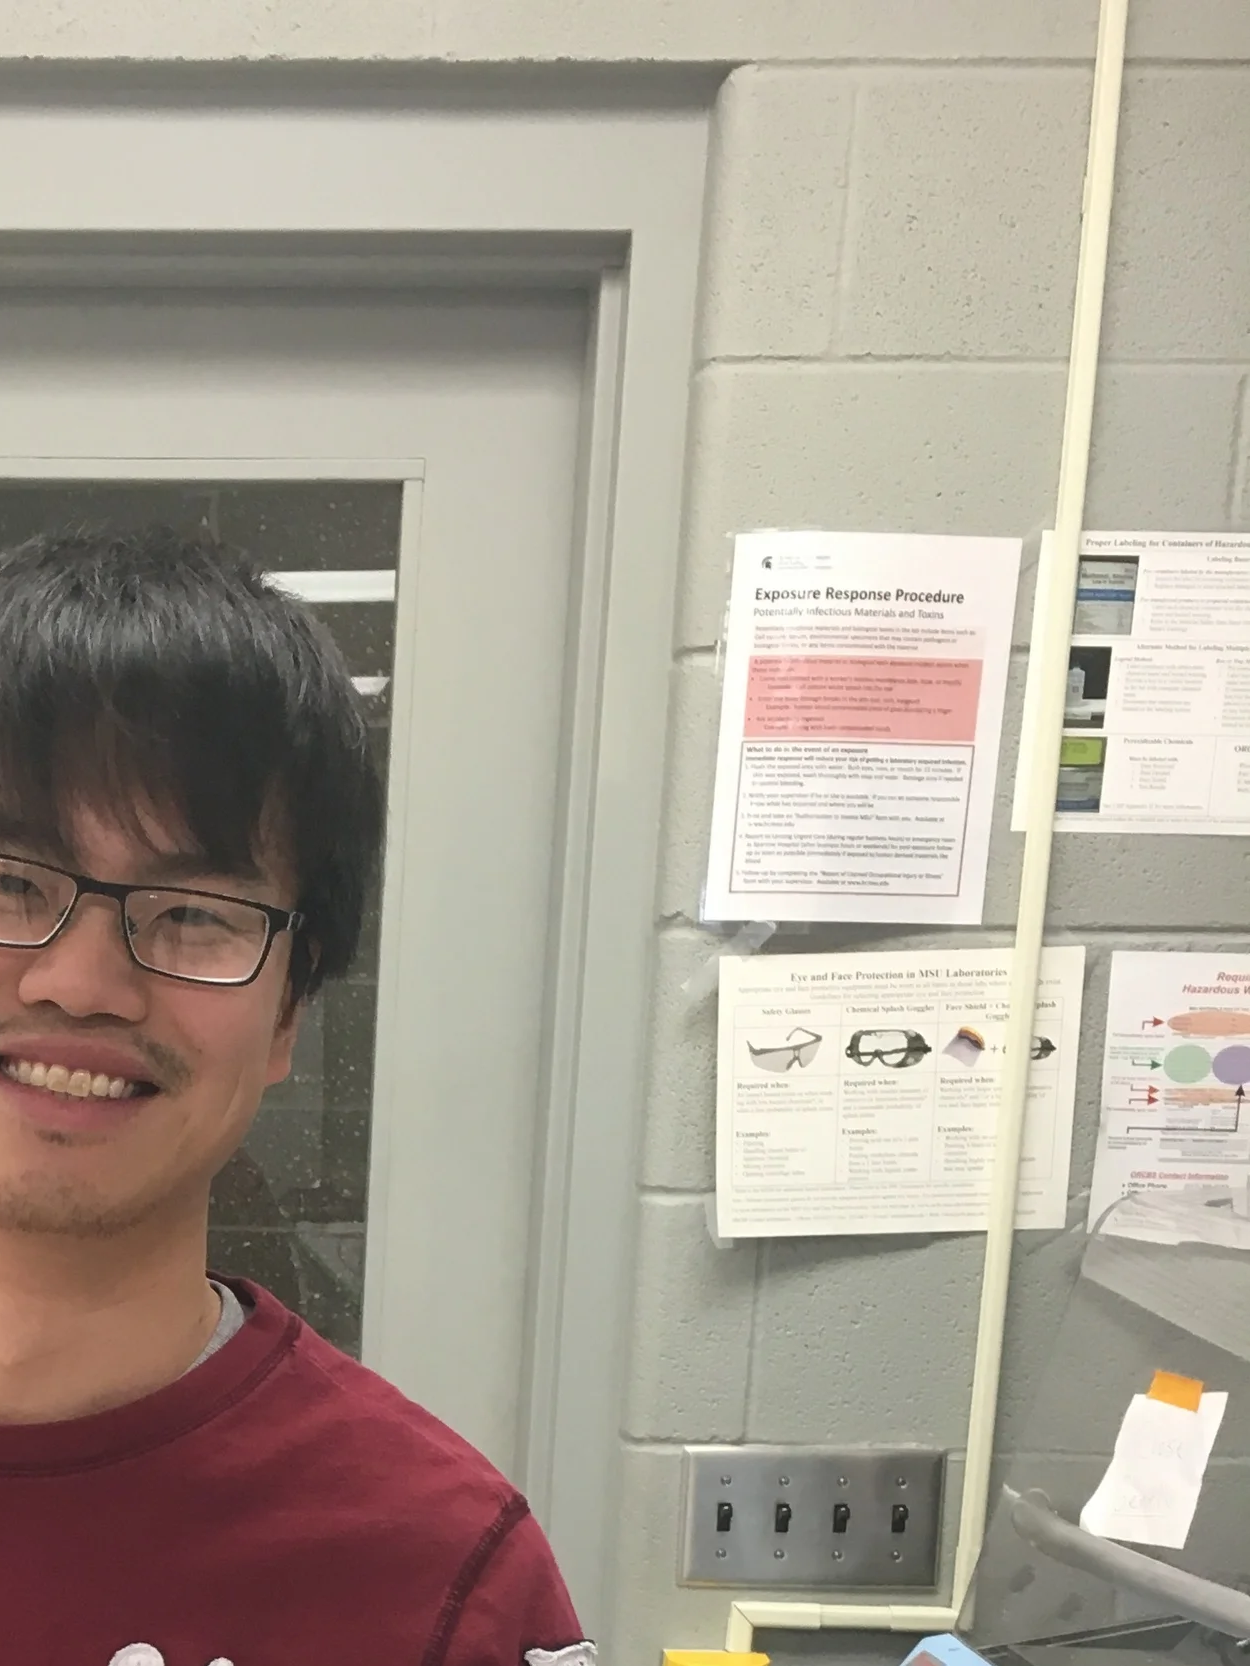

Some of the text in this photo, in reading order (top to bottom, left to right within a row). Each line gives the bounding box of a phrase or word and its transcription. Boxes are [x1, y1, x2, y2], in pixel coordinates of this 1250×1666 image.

[754, 586, 965, 605] Exposure Response Procedure
[753, 606, 945, 620] Potentially Infectious Materials and Toxins
[790, 972, 807, 984] Eye
[810, 971, 828, 982] and
[831, 971, 853, 982] Face
[855, 969, 903, 981] Protection
[906, 969, 916, 979] in
[946, 967, 1008, 978] Laboratories
[1181, 983, 1240, 995] Hazardous
[1035, 1000, 1057, 1011] plash
